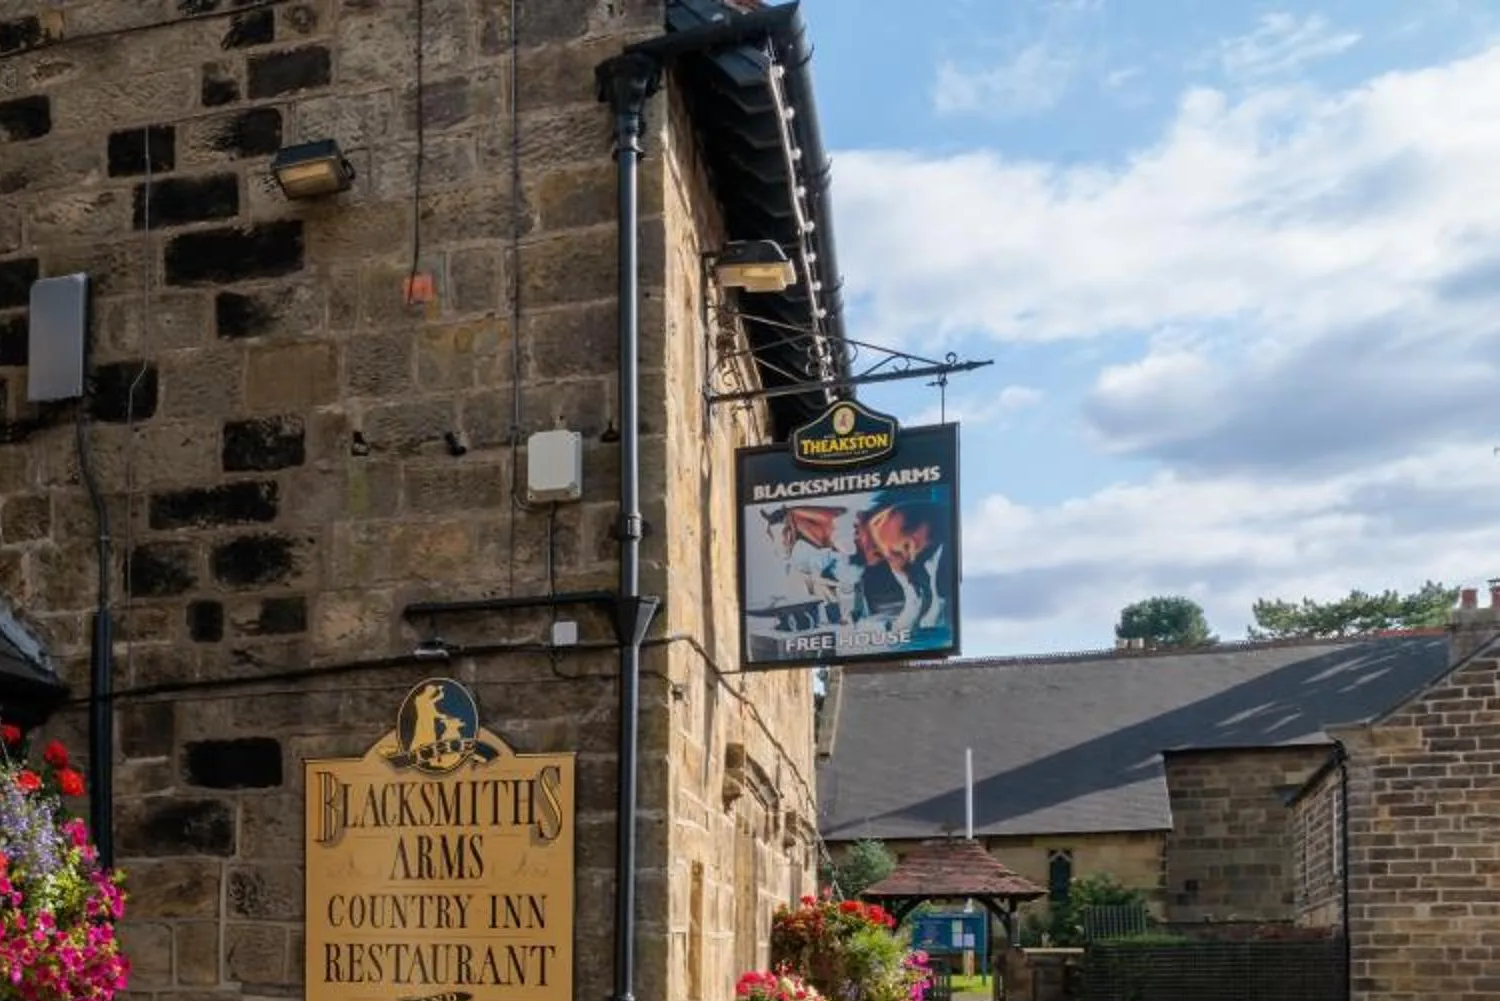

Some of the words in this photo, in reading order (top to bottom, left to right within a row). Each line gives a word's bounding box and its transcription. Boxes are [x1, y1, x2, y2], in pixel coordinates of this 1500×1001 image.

[801, 433, 888, 455] THEAKSTON
[753, 472, 882, 500] BLACKSMITHS
[886, 466, 941, 485] ARMS
[785, 635, 833, 652] FREE
[839, 630, 912, 647] HOUSE
[416, 739, 476, 766] THE
[316, 765, 563, 843] BLACKSMITHS
[389, 834, 485, 881] ARMS
[327, 895, 472, 929] COUNTRY
[487, 894, 547, 929] INN
[324, 943, 555, 987] RESTAURANT
